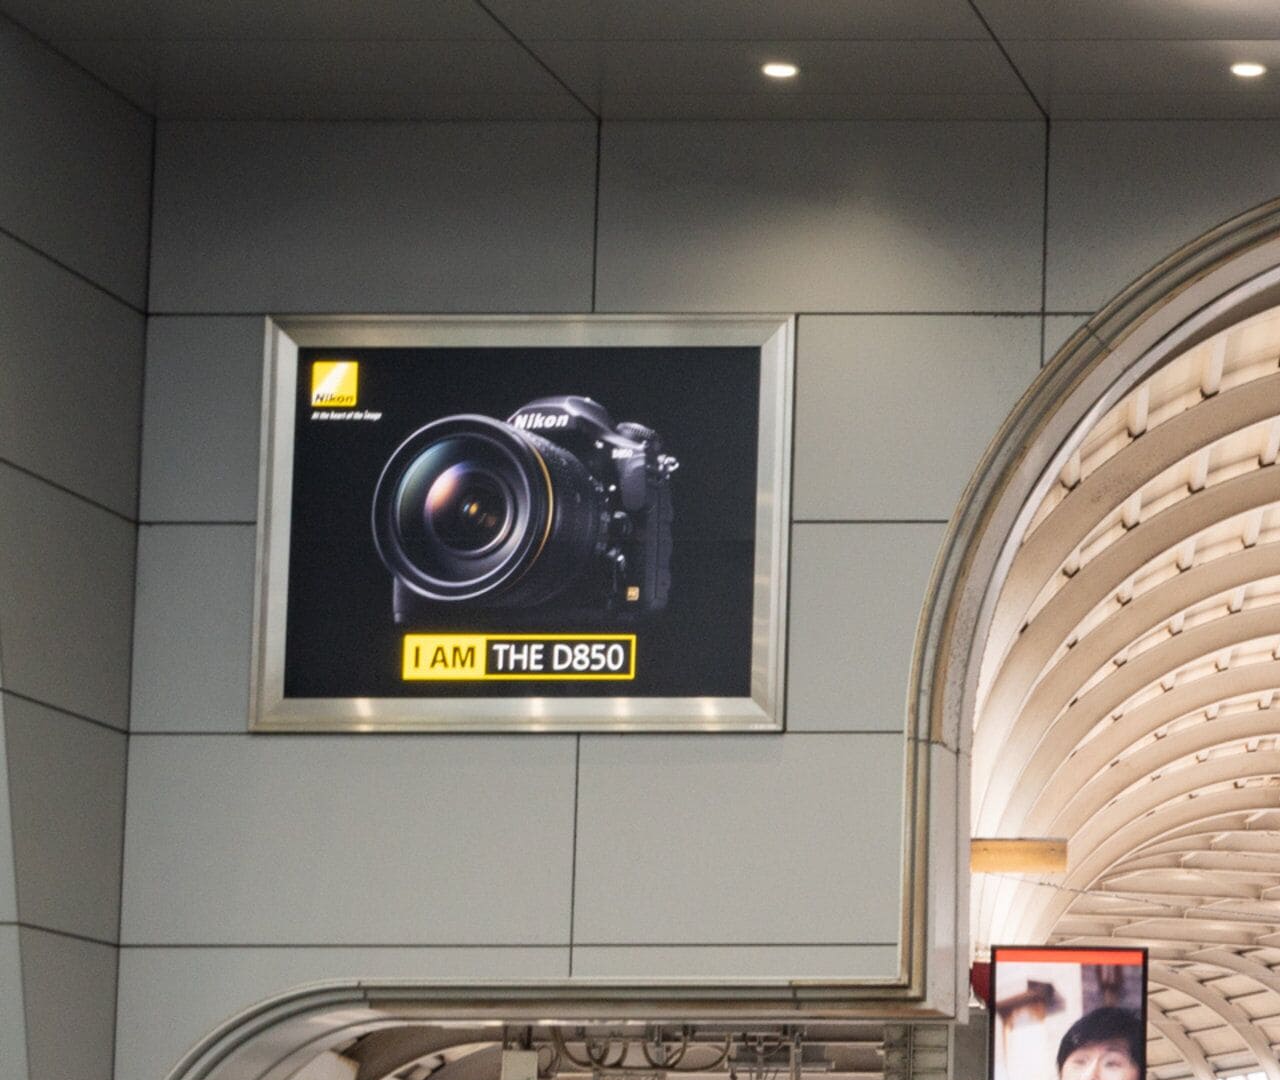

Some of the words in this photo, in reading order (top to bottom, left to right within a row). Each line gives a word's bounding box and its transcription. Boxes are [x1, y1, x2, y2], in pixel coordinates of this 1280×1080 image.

[315, 393, 354, 404] Nikon
[514, 412, 569, 429] Nikon
[414, 645, 421, 668] I
[430, 645, 476, 668] AM
[492, 643, 544, 671] THE
[552, 643, 625, 671] D850
